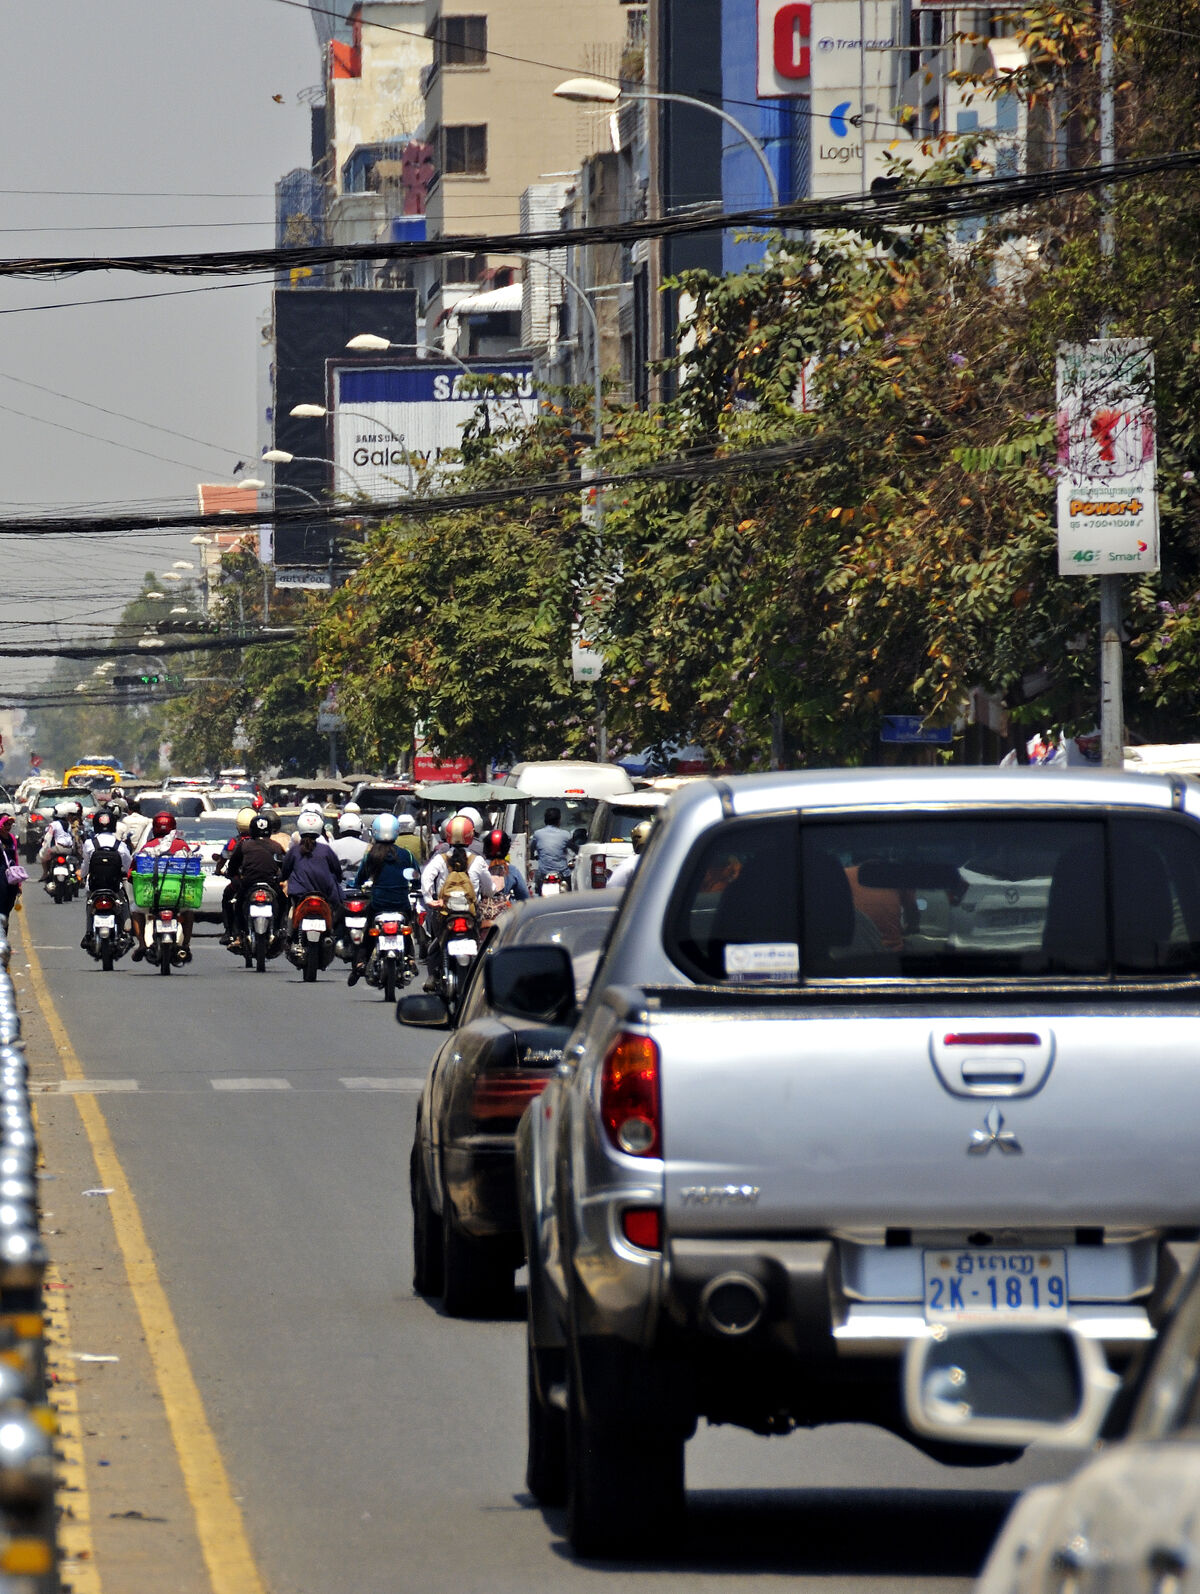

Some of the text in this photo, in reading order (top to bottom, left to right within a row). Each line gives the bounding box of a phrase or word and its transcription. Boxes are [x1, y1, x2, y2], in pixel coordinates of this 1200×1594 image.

[837, 37, 895, 49] Trancend
[1073, 550, 1142, 562] 4G Smart
[929, 1275, 1064, 1310] 2K-1819
